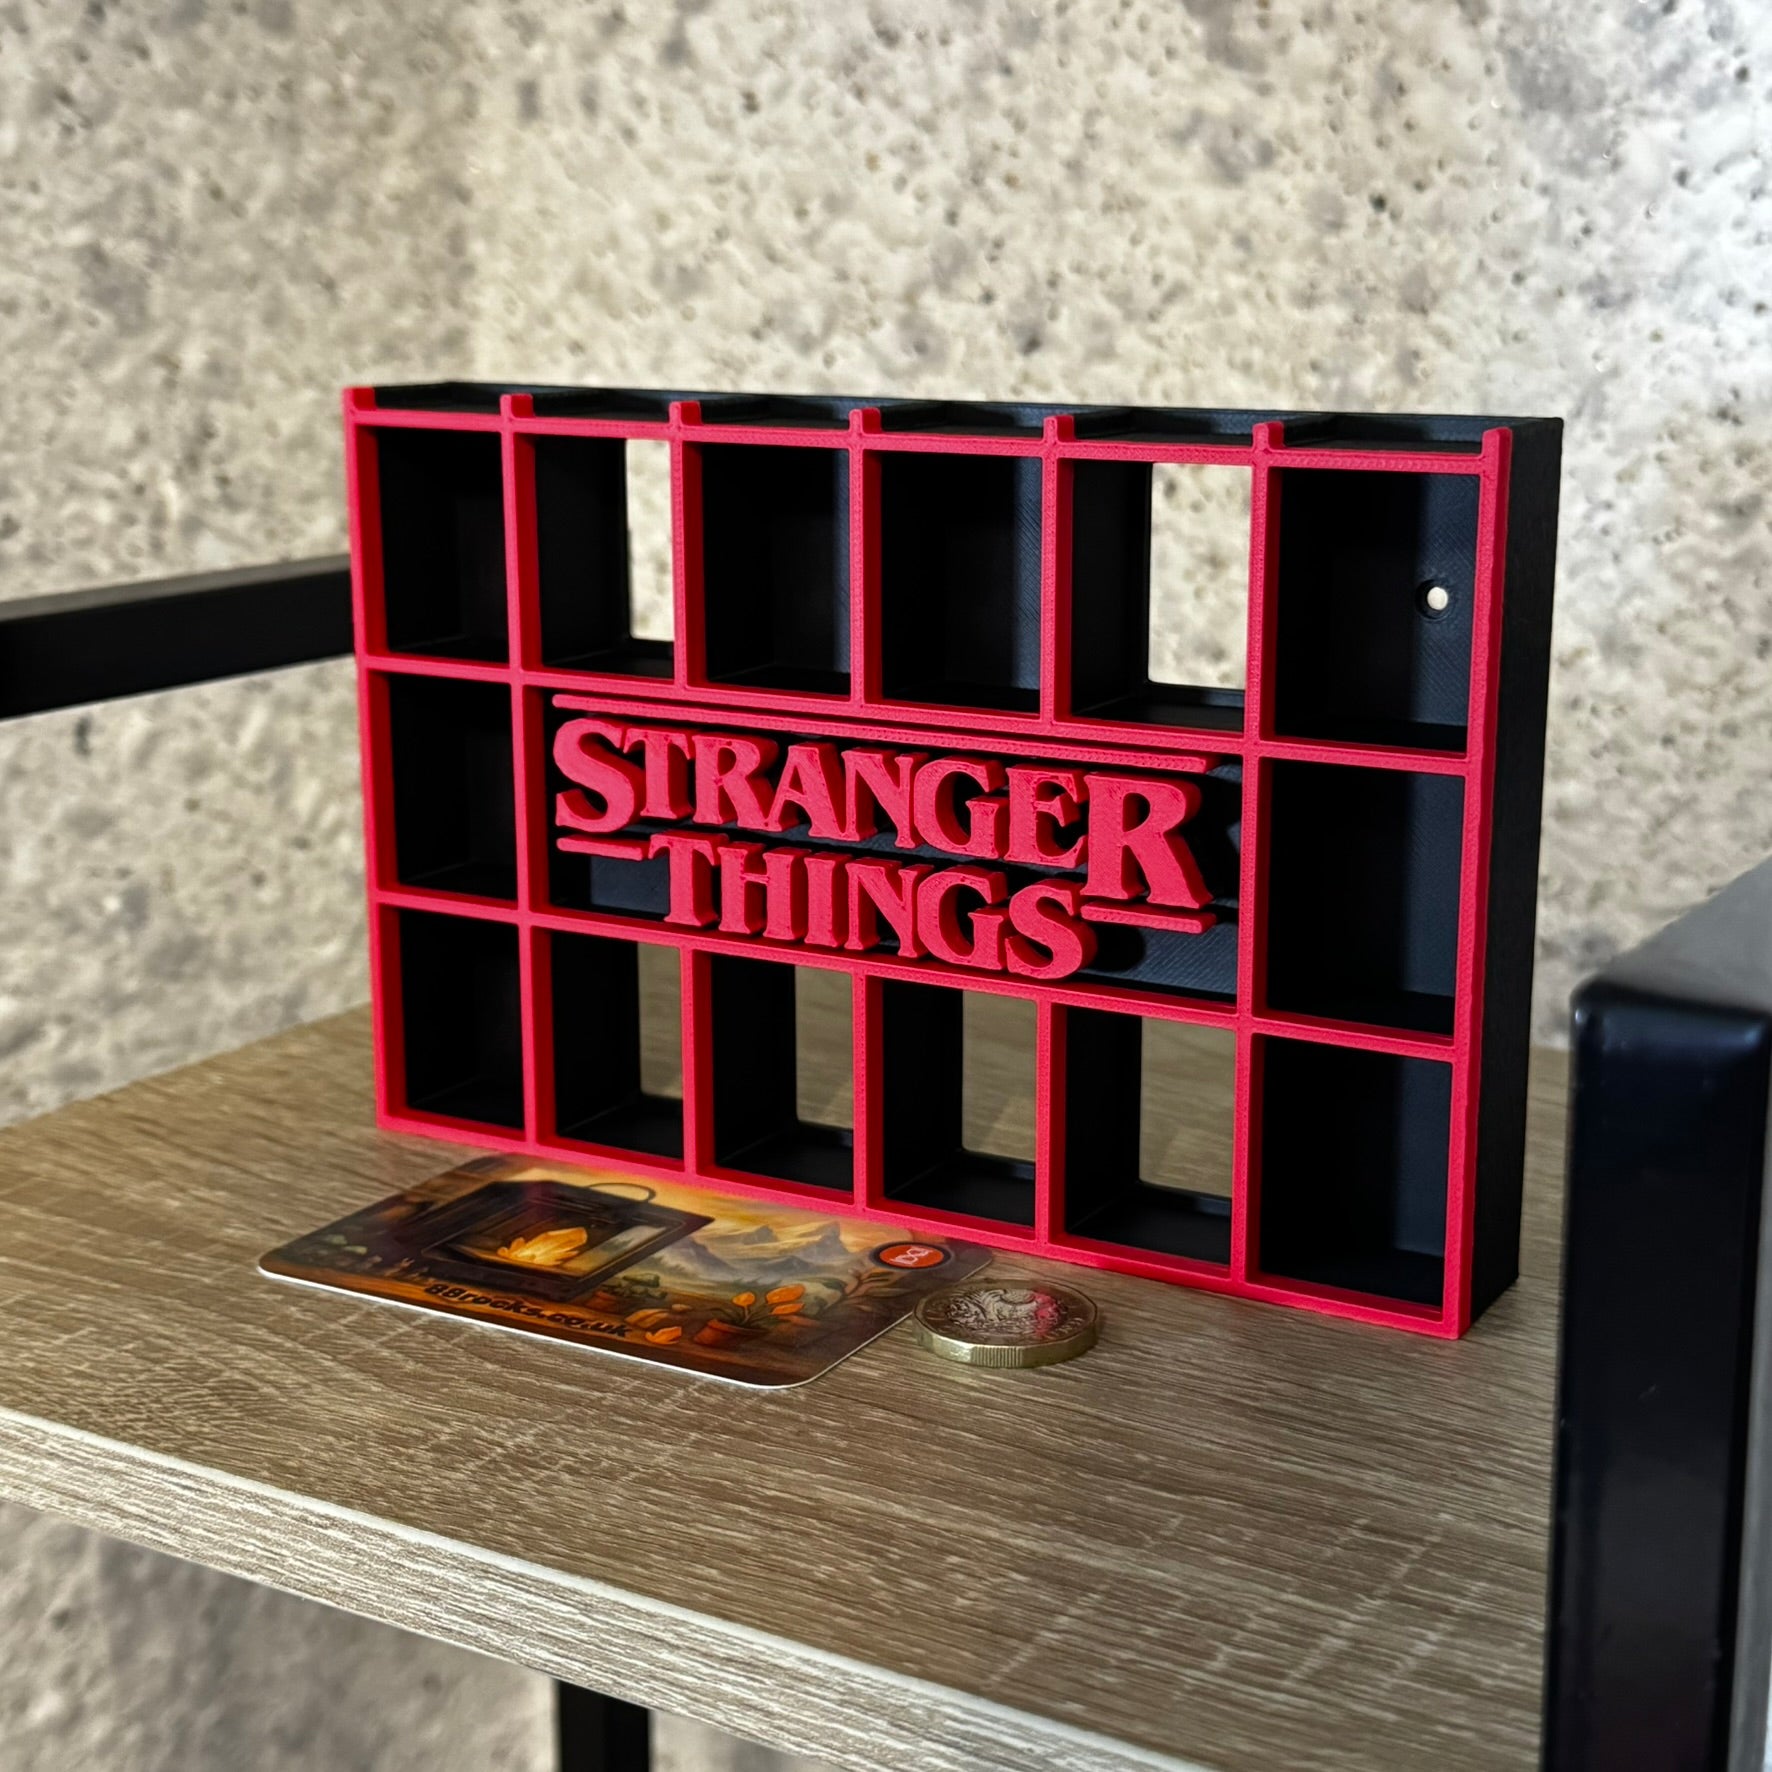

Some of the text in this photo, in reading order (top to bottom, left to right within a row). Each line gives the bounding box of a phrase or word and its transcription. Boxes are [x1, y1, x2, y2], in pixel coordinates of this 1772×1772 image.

[553, 718, 1213, 909] STRANGER
[648, 829, 1097, 979] THINGS
[424, 1283, 631, 1337] 88rocks.co.uk
